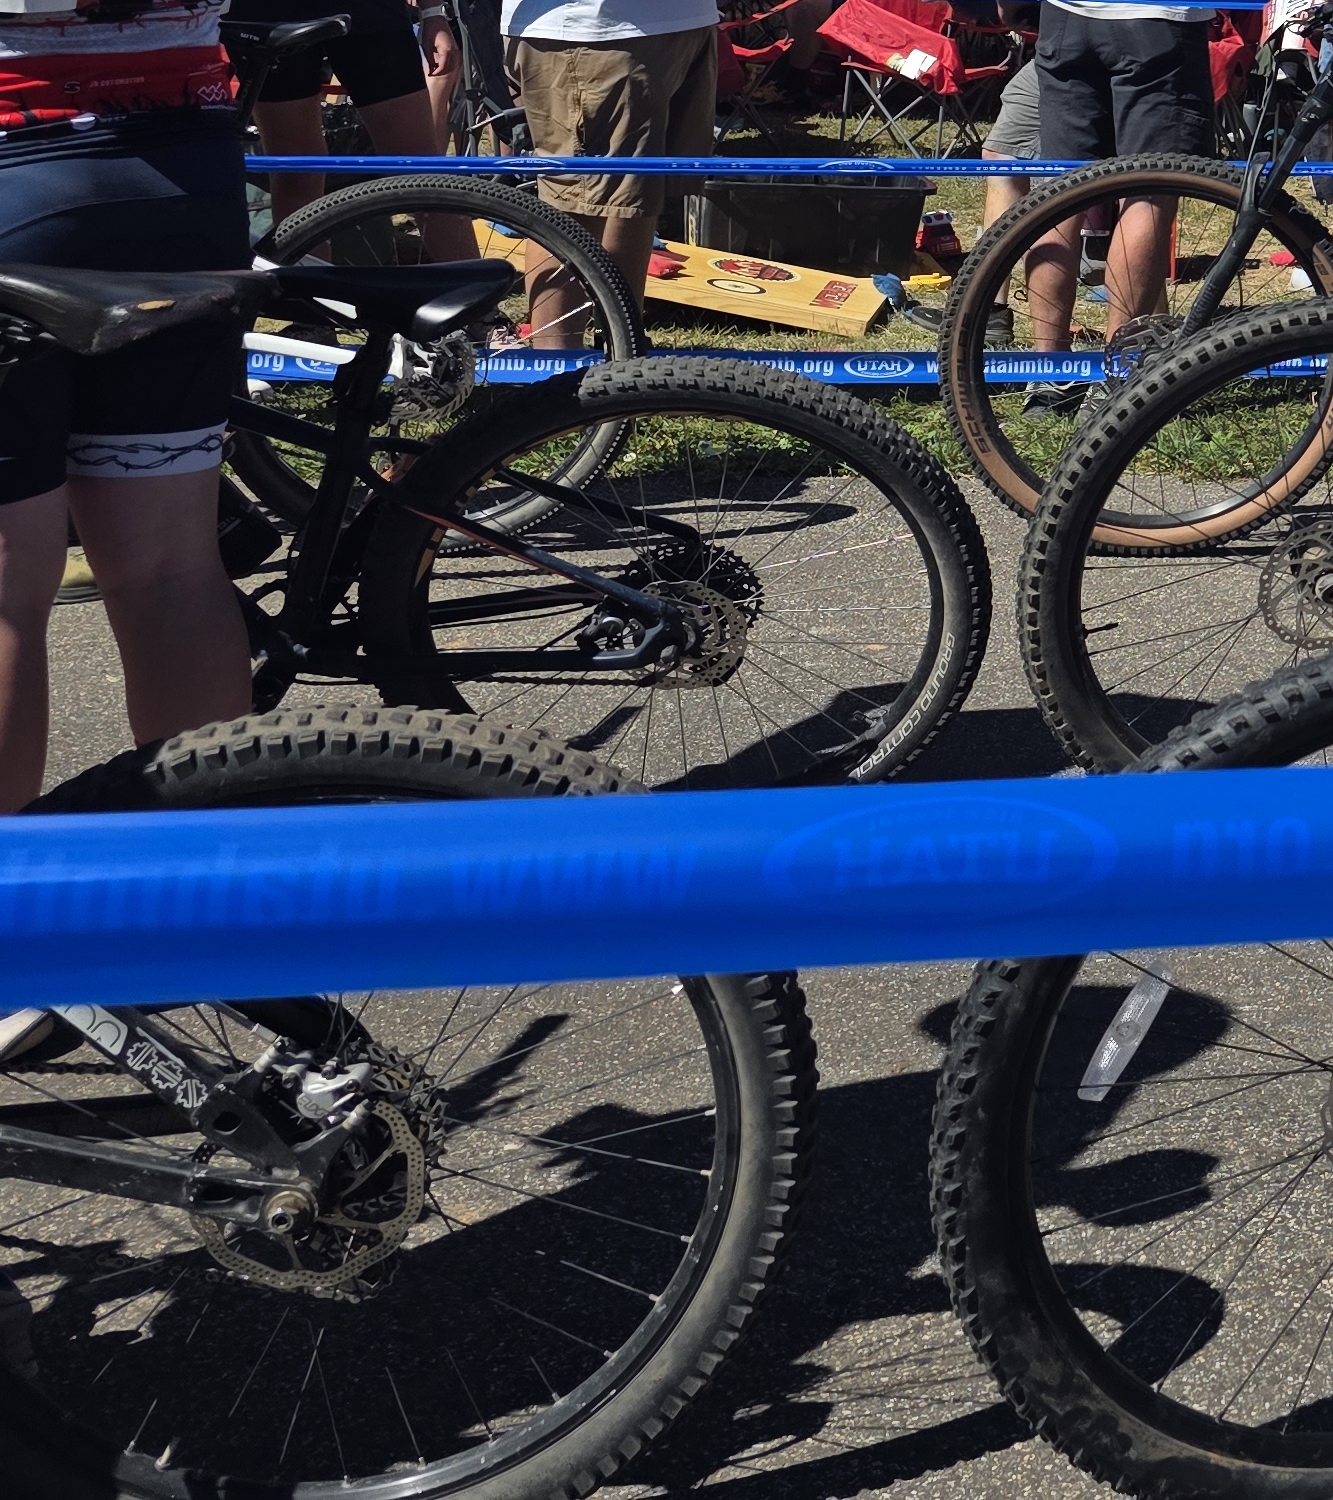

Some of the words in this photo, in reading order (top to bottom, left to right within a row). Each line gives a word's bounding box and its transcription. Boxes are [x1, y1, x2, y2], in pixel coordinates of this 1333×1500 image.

[857, 359, 903, 373] UTAH
[920, 632, 956, 712] GROUND
[856, 710, 922, 778] CONTROL
